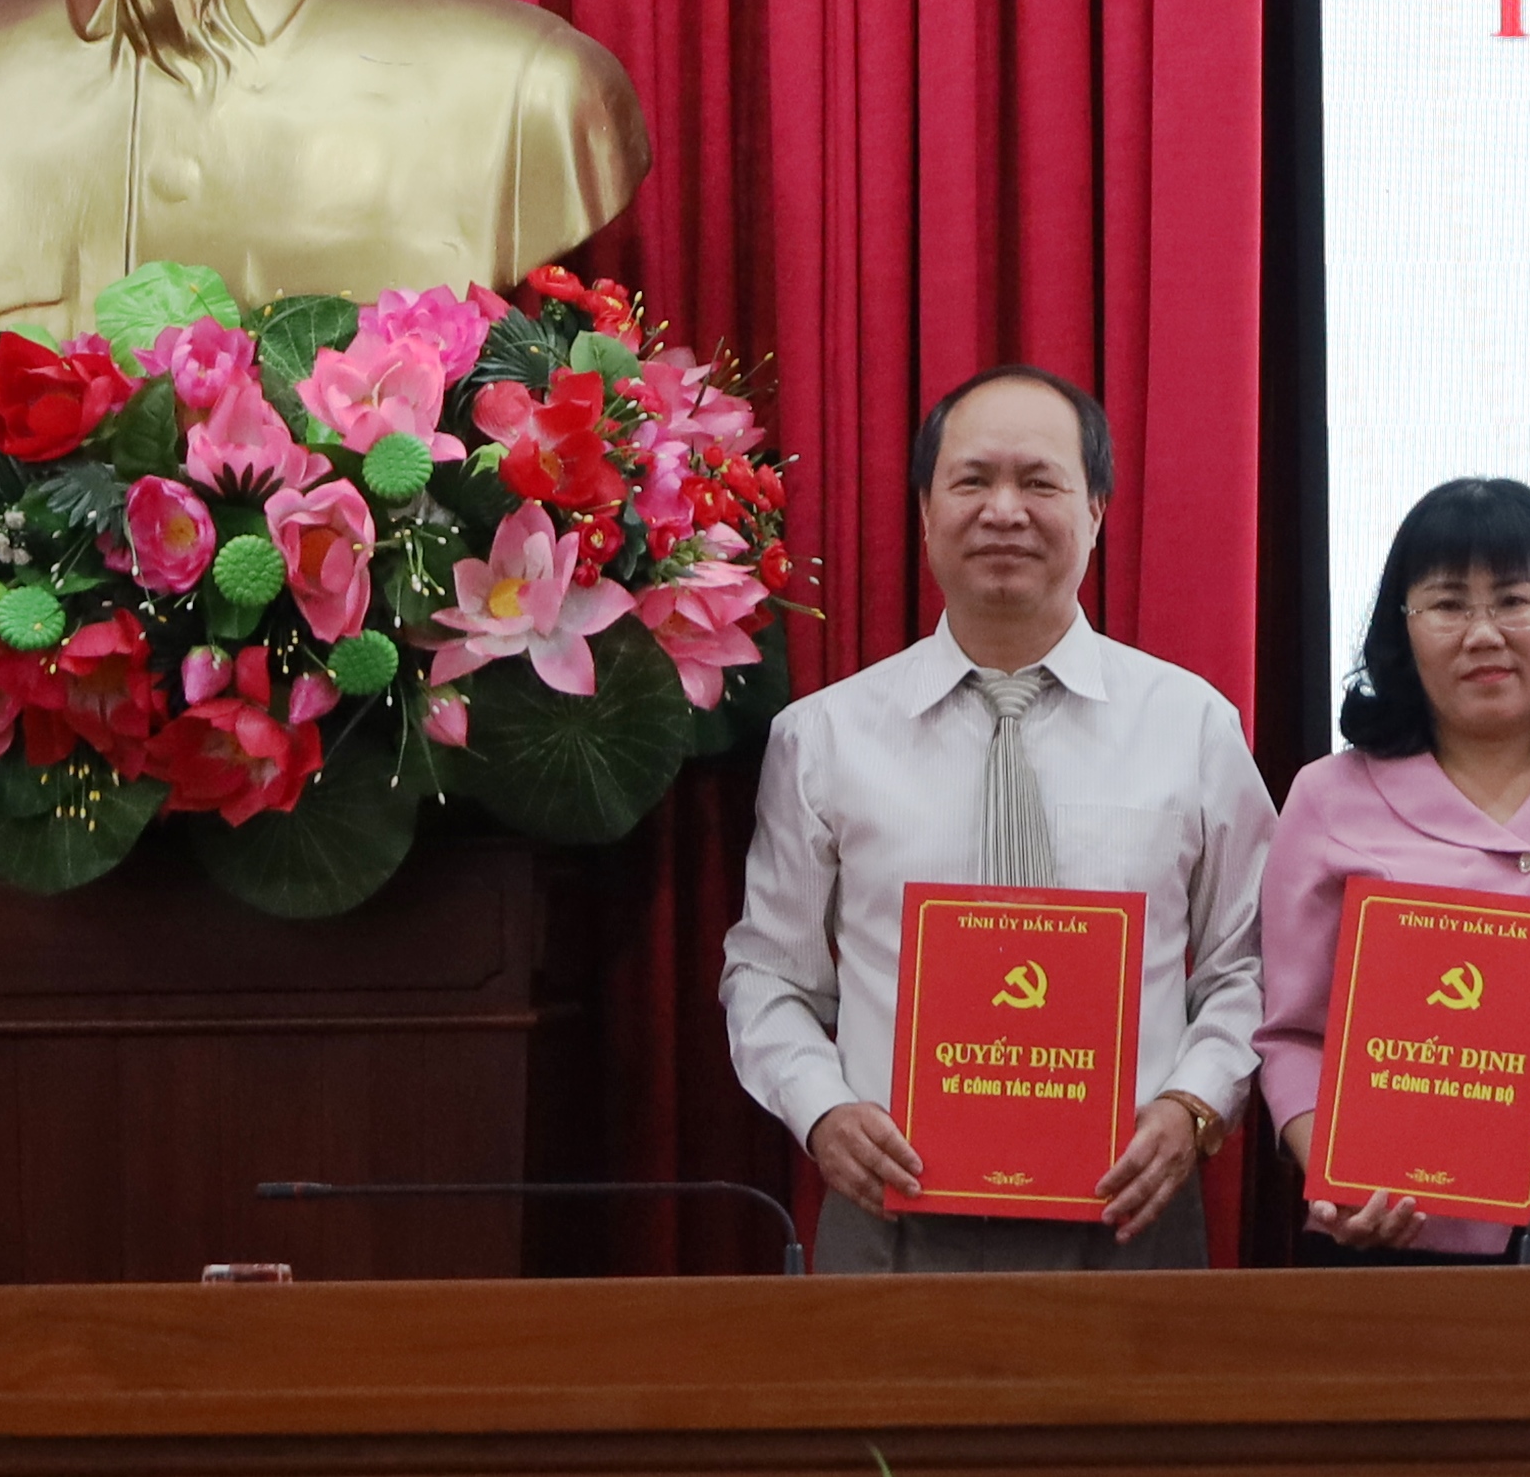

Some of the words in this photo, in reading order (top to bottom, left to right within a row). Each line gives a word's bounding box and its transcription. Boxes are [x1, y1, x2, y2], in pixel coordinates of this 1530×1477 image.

[958, 912, 994, 929] TỈNH
[999, 914, 1019, 930] ỦY
[1398, 911, 1435, 929] TỈNH
[1439, 914, 1459, 931] ỦY
[935, 1036, 1023, 1068] QUYẾT
[1029, 1046, 1095, 1073] ĐỊNH
[1366, 1035, 1454, 1066] QUYẾT
[1459, 1048, 1526, 1075] ĐỊNH
[942, 1074, 960, 1094] VỀ
[963, 1076, 1002, 1096] CÔNG
[1005, 1078, 1031, 1097] TÁC
[1034, 1079, 1064, 1099] CÁN
[1067, 1081, 1087, 1103] BỘ
[1370, 1069, 1390, 1089] VỀ
[1391, 1073, 1431, 1094] CÔNG
[1433, 1078, 1460, 1097] TÁC
[1462, 1081, 1493, 1101] CÁN
[1494, 1085, 1515, 1106] BỘ
